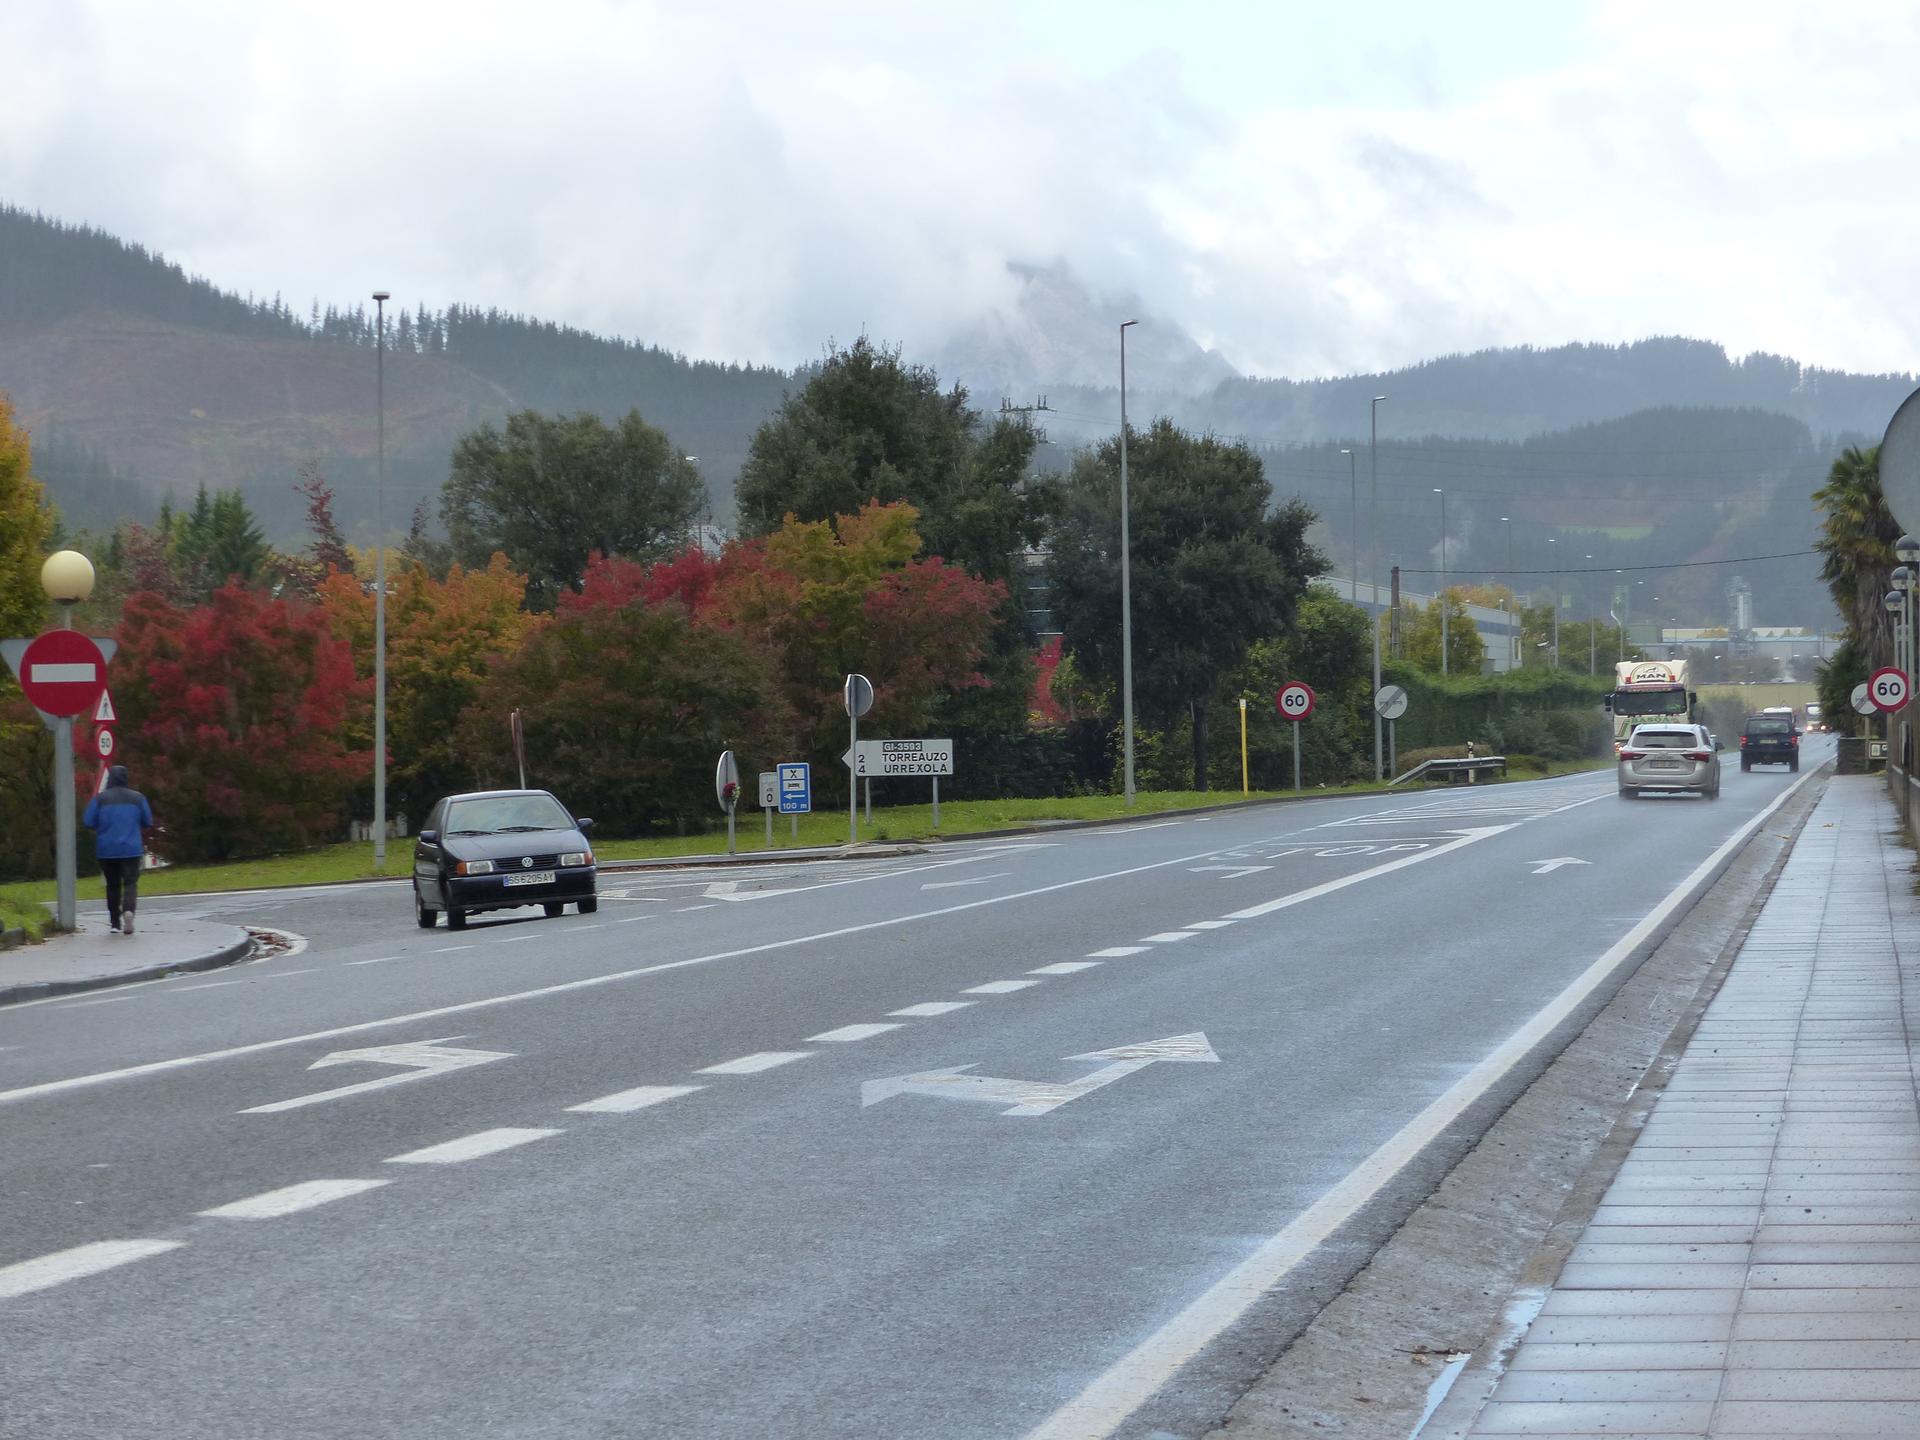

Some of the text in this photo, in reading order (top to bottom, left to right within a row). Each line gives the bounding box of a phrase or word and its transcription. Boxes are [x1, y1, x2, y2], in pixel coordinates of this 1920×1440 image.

[1877, 682, 1901, 696] 60
[1285, 694, 1305, 707] 60
[101, 738, 111, 748] 50
[884, 742, 921, 751] GI-3593
[858, 752, 948, 763] 2 TORREAUZO
[858, 764, 948, 774] 4 URREXOLA
[783, 802, 798, 810] 100
